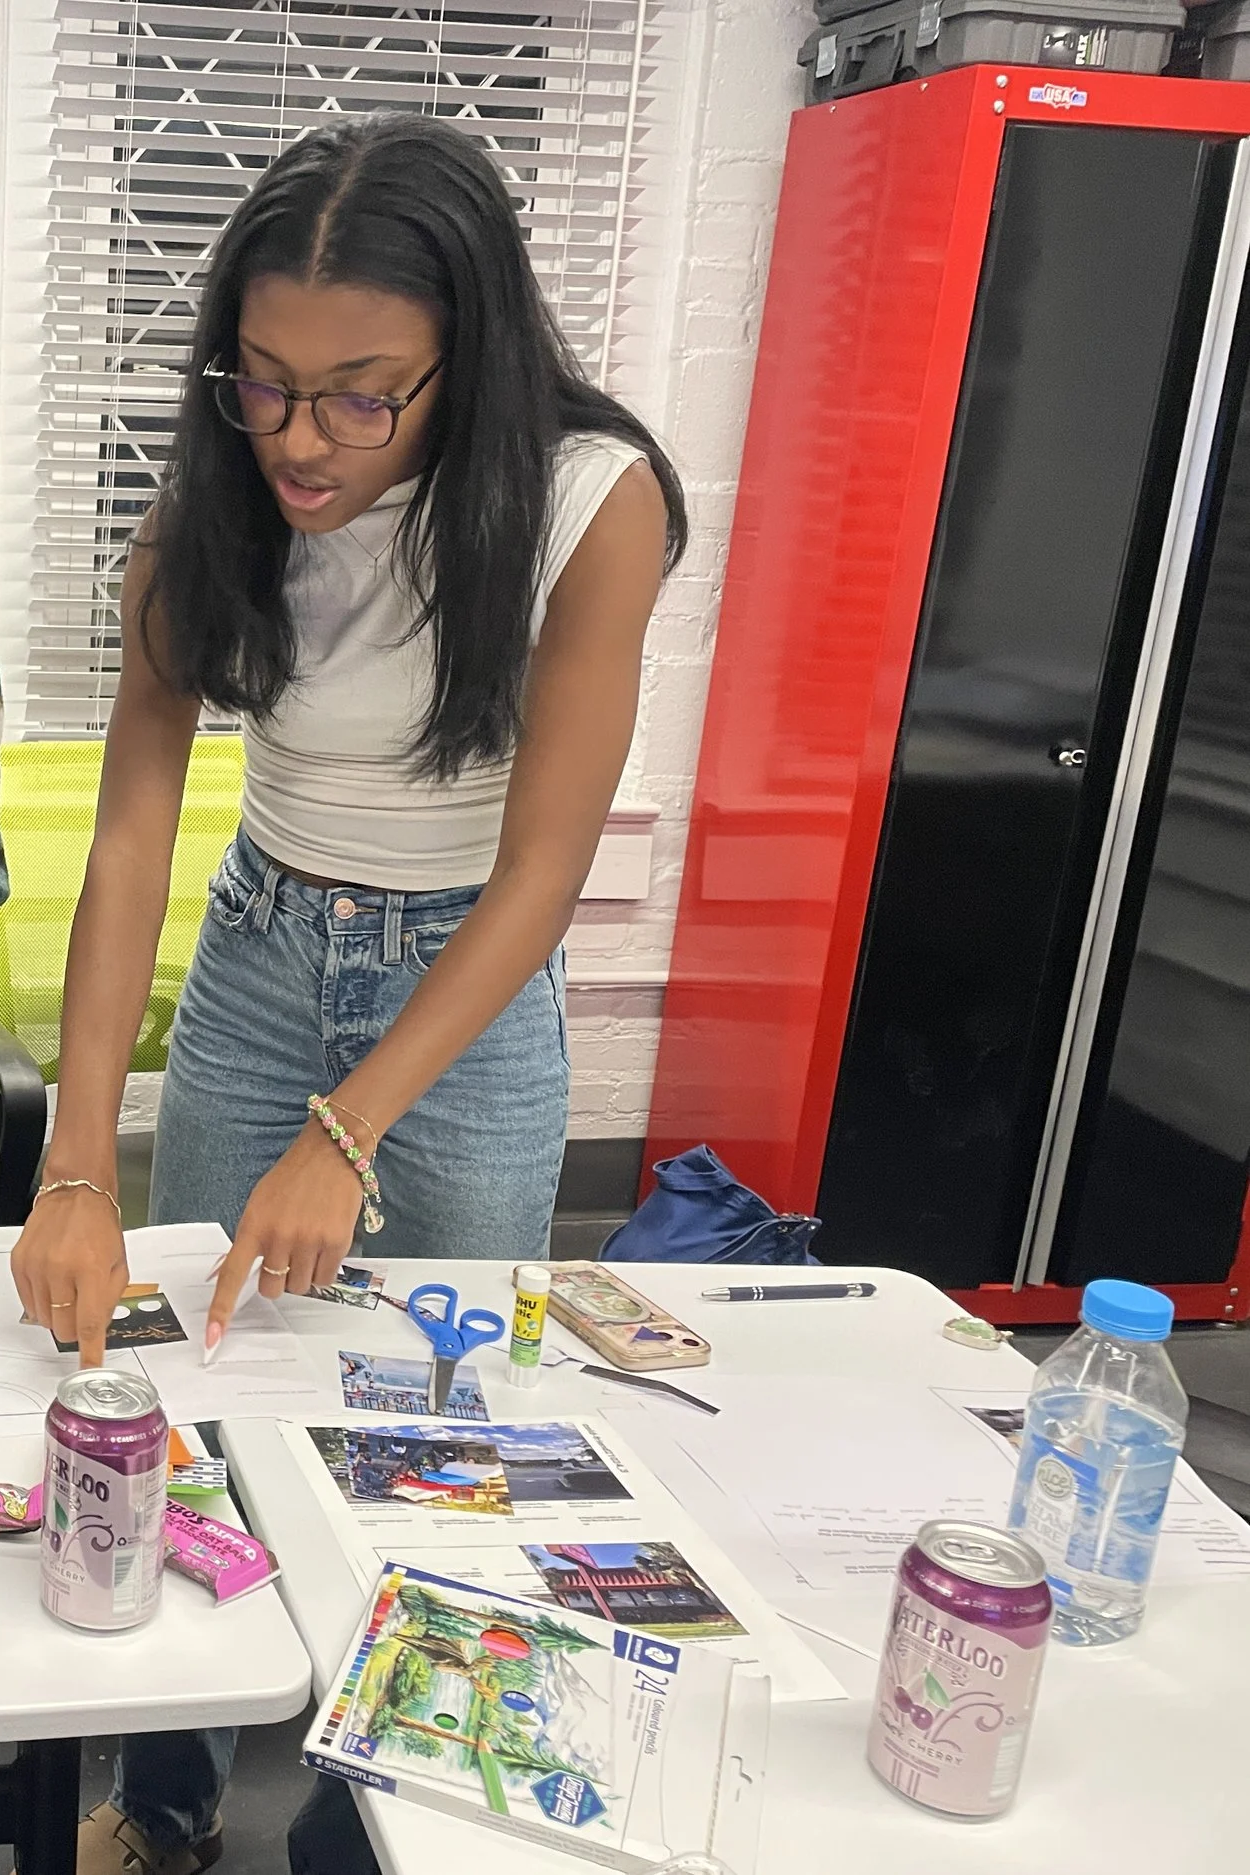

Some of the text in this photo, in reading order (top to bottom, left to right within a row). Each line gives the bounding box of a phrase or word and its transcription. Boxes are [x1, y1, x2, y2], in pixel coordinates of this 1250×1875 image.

[1075, 34, 1089, 65] FLEX
[1045, 86, 1070, 102] USA
[51, 1453, 110, 1503] ERLOO
[176, 1526, 228, 1556] CHOCOLATE
[199, 1531, 224, 1546] OAT
[223, 1544, 247, 1564] BAR
[205, 1524, 257, 1562] DIPP'D
[51, 1561, 86, 1582] CHERRY
[633, 1668, 670, 1696] 24
[648, 1699, 666, 1731] Coloured
[644, 1730, 658, 1756] pencils
[908, 1738, 964, 1766] CHERRY
[324, 1760, 383, 1787] STAEDTLER
